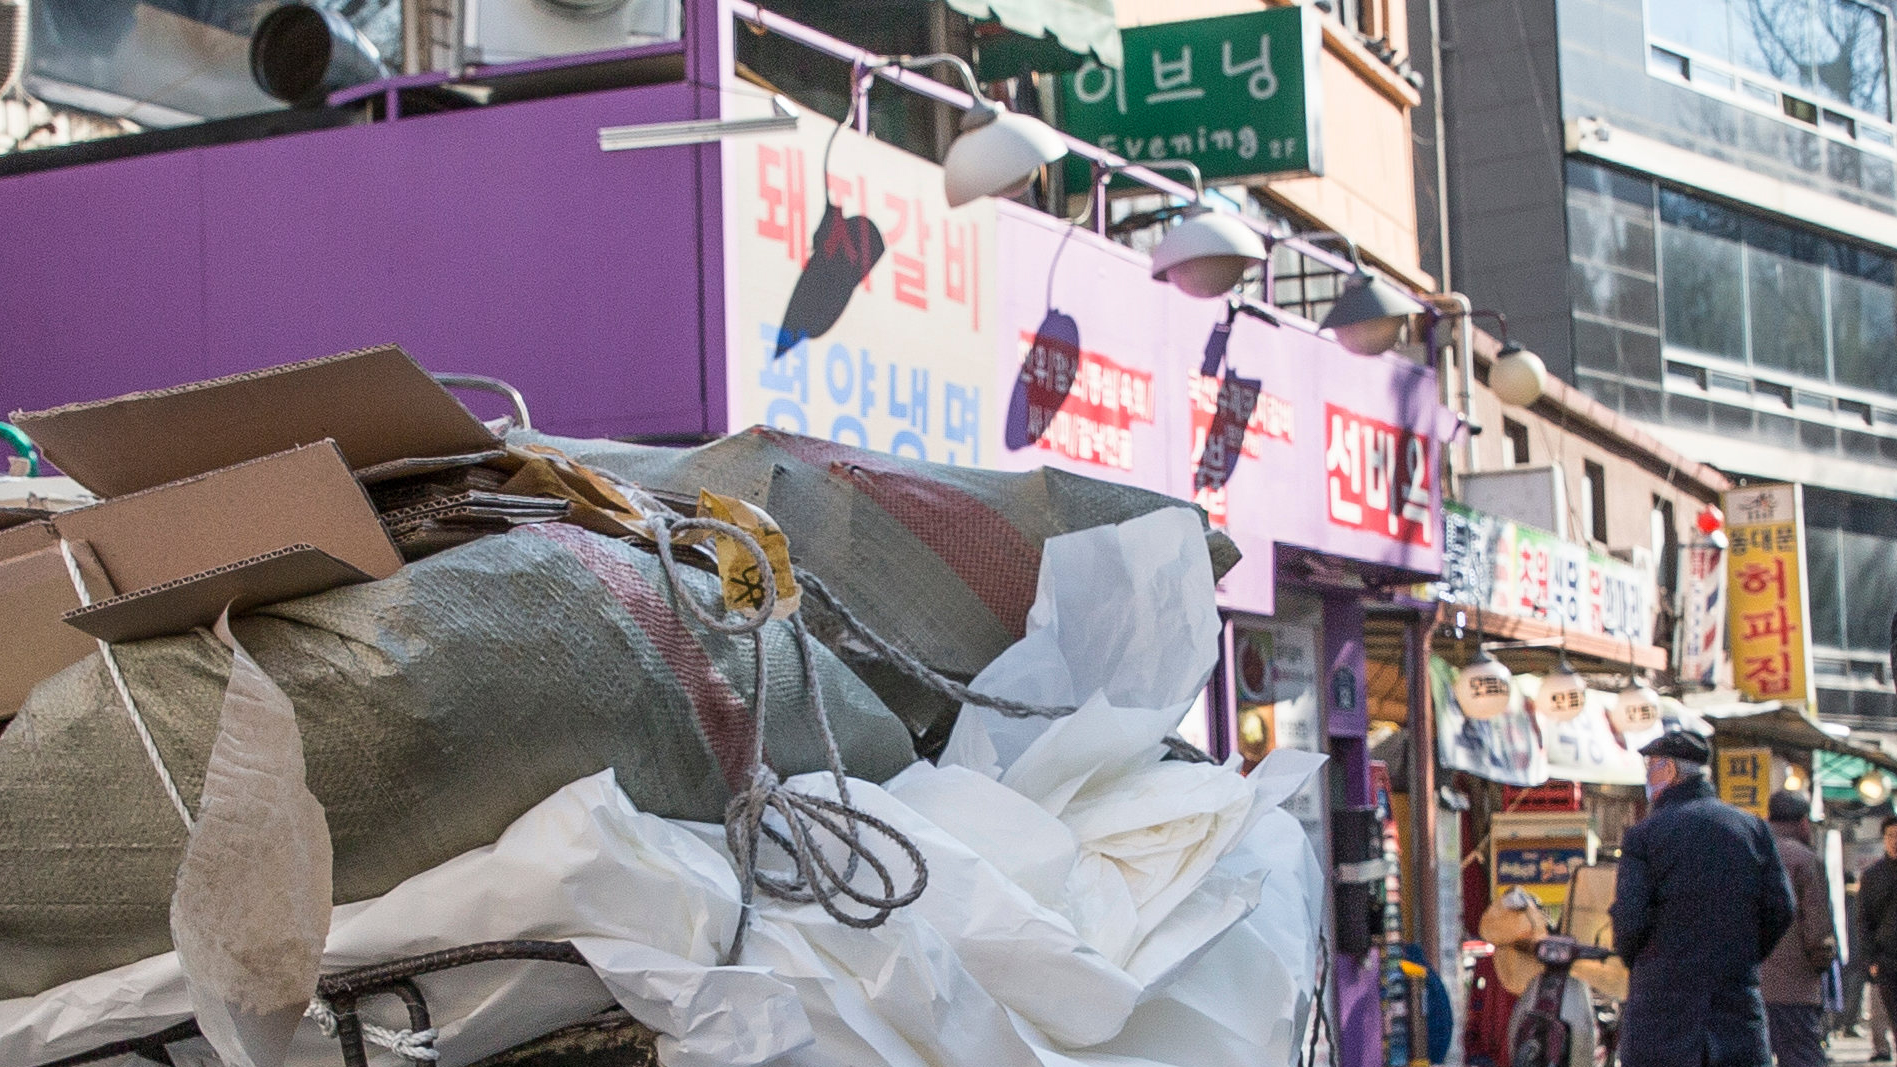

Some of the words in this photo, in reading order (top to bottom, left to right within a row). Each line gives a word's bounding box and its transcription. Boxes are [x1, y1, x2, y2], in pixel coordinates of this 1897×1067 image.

[1074, 33, 1279, 113] 이브닝
[757, 144, 980, 332] 돼지갈비
[758, 322, 980, 466] 평양냉면
[1326, 411, 1432, 547] 선비옥
[1731, 526, 1794, 556] 동대문
[1735, 557, 1797, 695] 허파집
